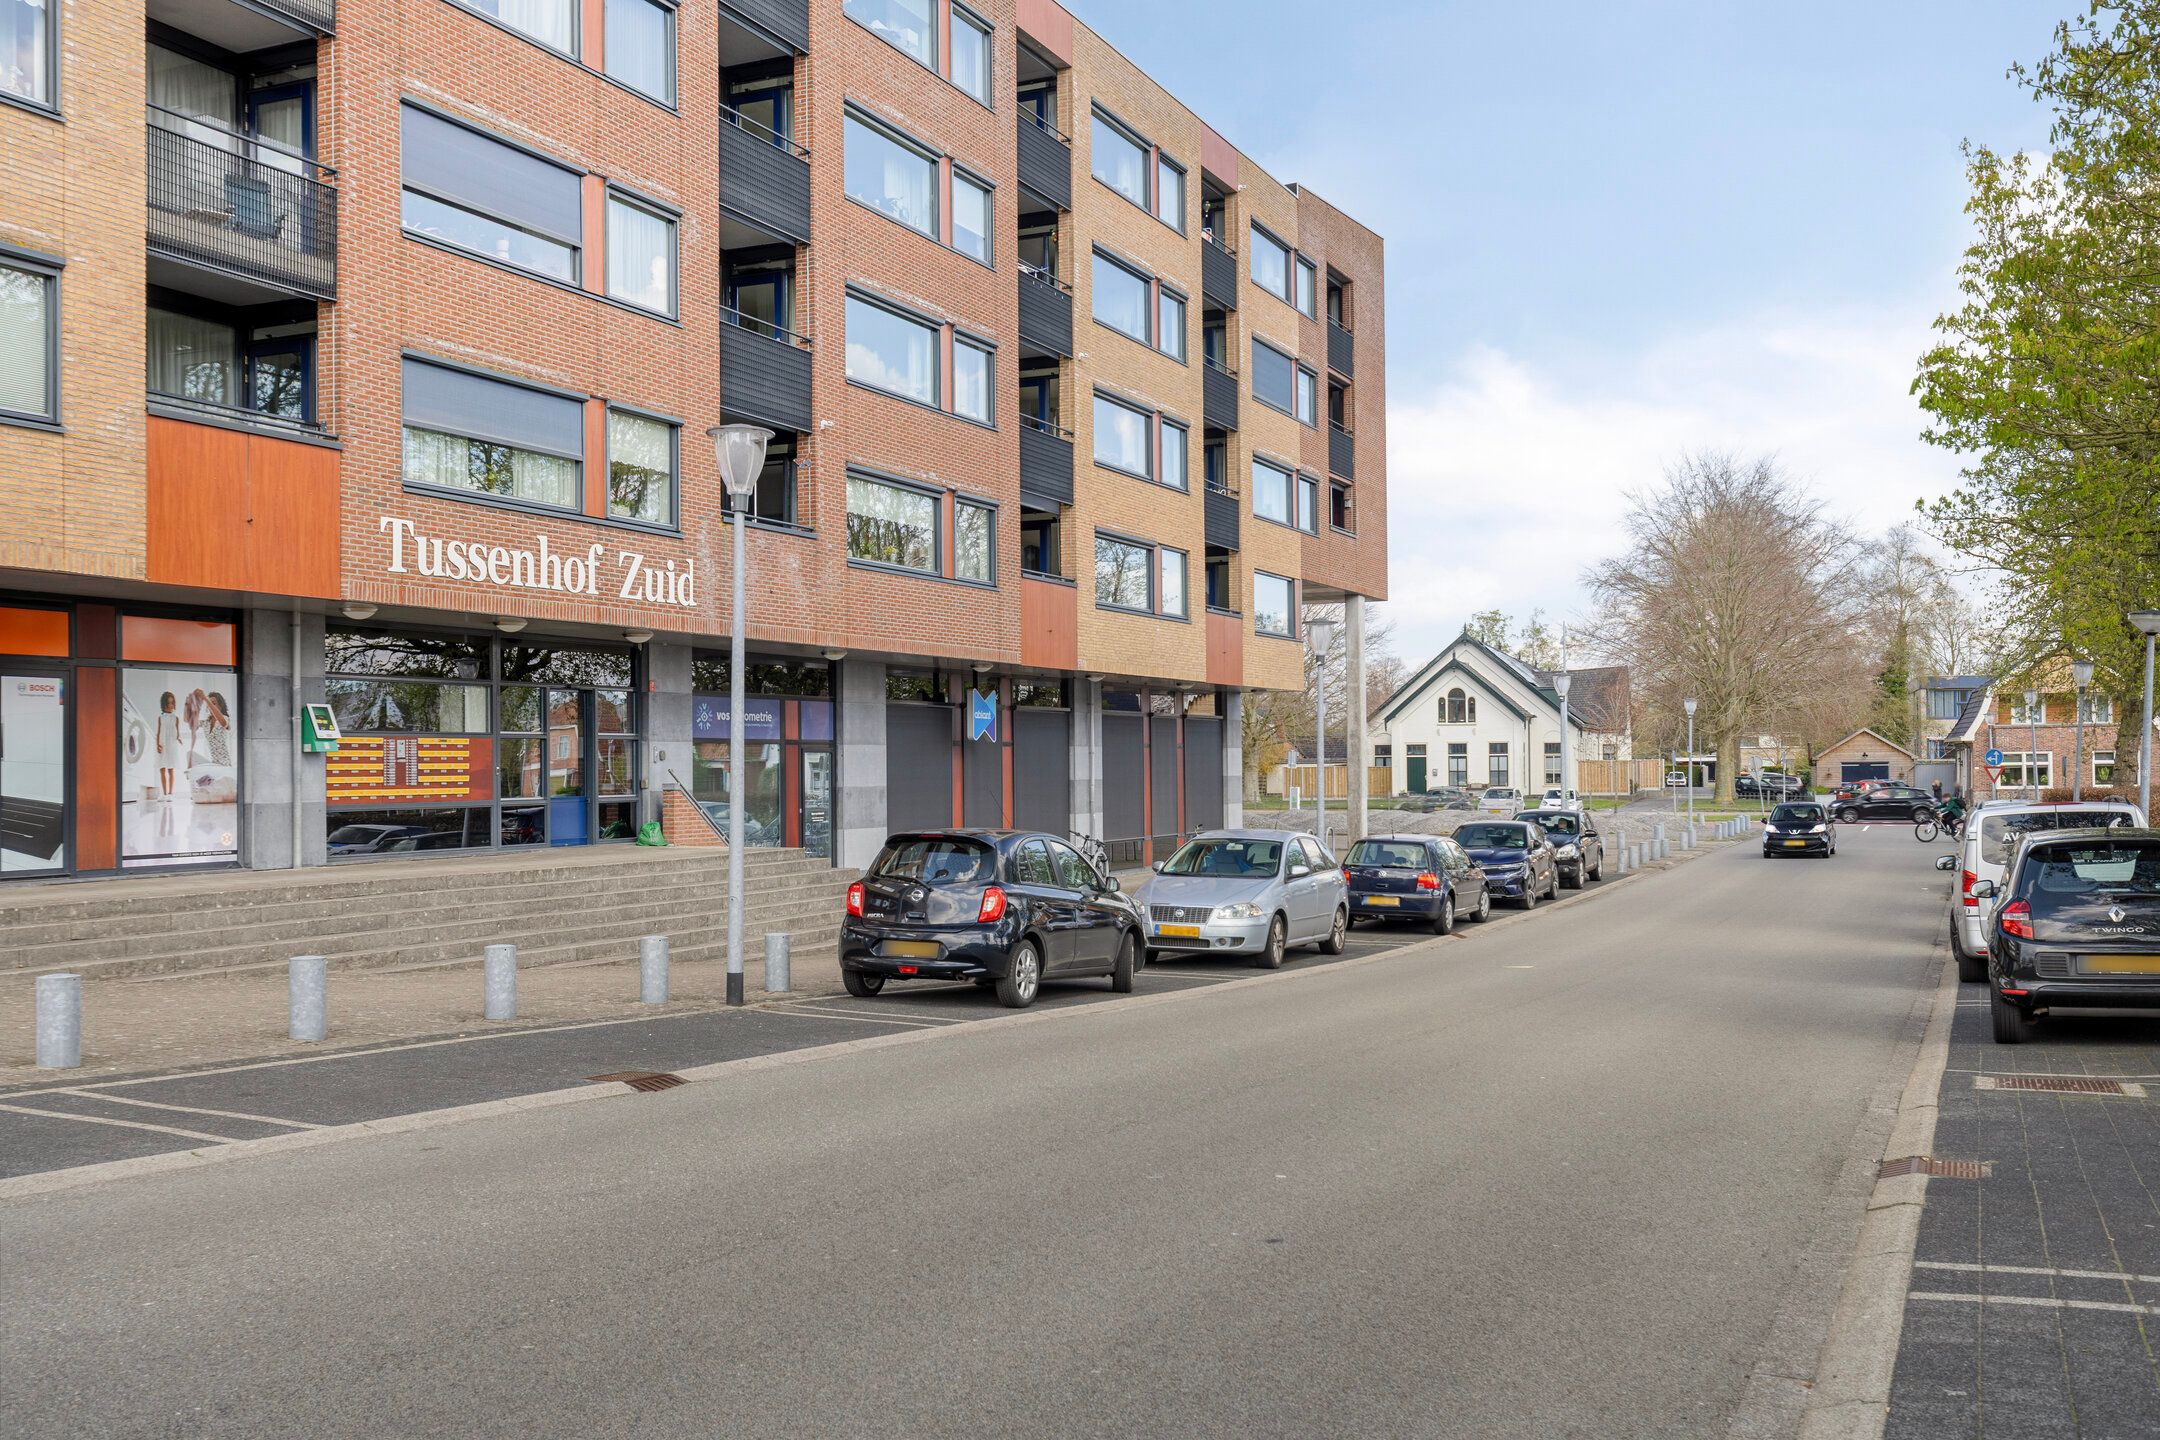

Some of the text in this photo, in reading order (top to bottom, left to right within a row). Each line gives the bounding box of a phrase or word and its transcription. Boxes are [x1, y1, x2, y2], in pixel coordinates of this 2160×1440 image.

[380, 516, 697, 607] Tussenhof Zuid
[716, 711, 773, 722] vos ometrie
